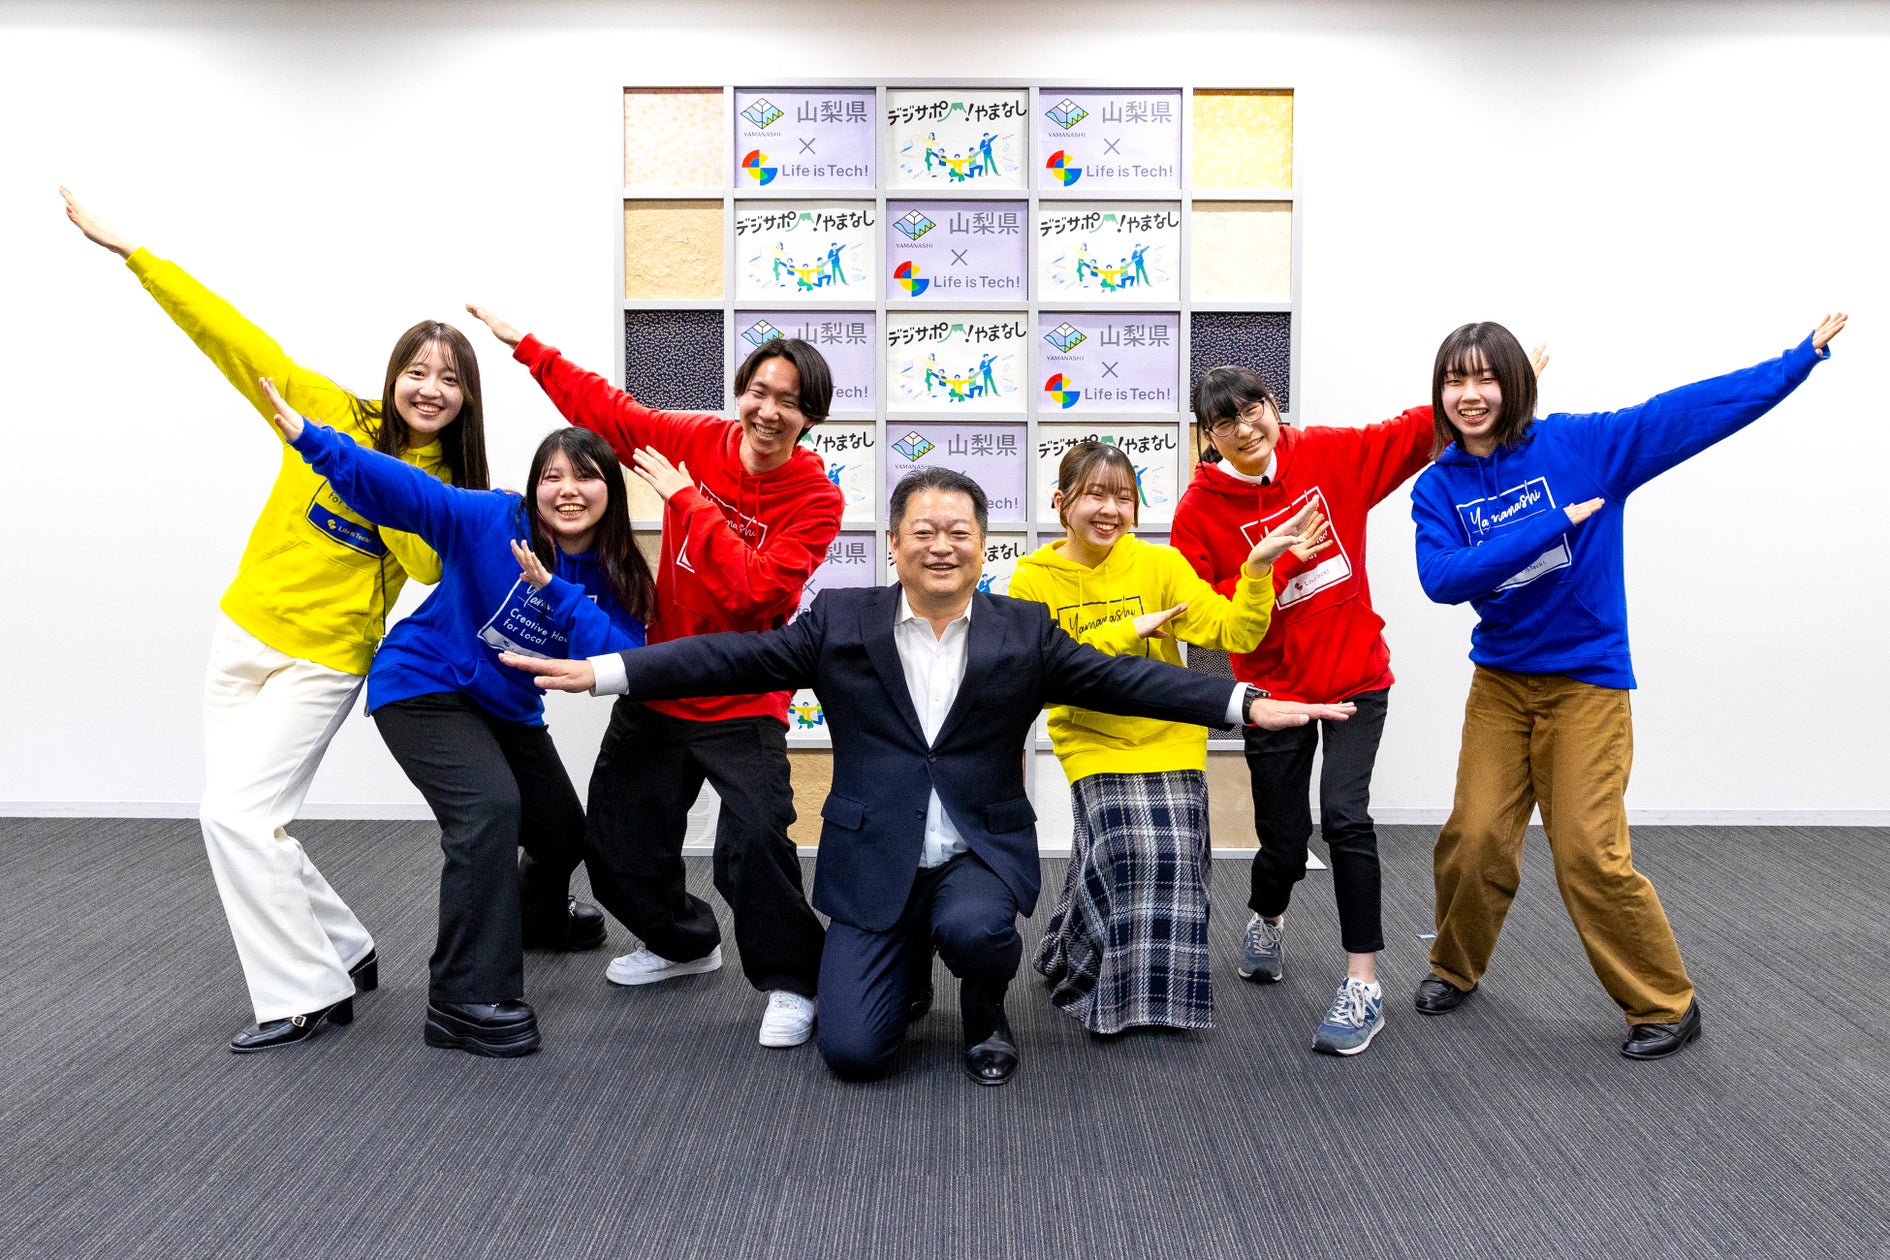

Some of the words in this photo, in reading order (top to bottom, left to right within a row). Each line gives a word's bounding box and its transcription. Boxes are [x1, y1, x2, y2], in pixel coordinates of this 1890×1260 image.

[797, 100, 867, 123] 山梨県
[1102, 101, 1172, 123] 山梨県
[782, 164, 810, 177] Life
[814, 164, 825, 177] is
[827, 164, 868, 177] Tech!
[1086, 165, 1114, 178] Life
[1117, 165, 1129, 178] is
[1132, 165, 1172, 178] Tech!
[949, 212, 1019, 235] 山梨県
[933, 275, 962, 288] Life
[965, 275, 977, 288] is
[979, 275, 1020, 288] Tech!
[797, 322, 867, 345] 山梨県
[1100, 324, 1170, 347] 山梨県
[1085, 388, 1112, 400] Life
[1116, 388, 1128, 400] is
[1129, 388, 1170, 401] Tech!
[948, 434, 1018, 456] 山梨県
[987, 497, 1018, 509] ech!
[825, 542, 867, 564] 梨県
[510, 608, 548, 635] Creative
[1069, 596, 1136, 641] Yamanashi
[503, 618, 519, 632] for
[520, 628, 547, 646] Local
